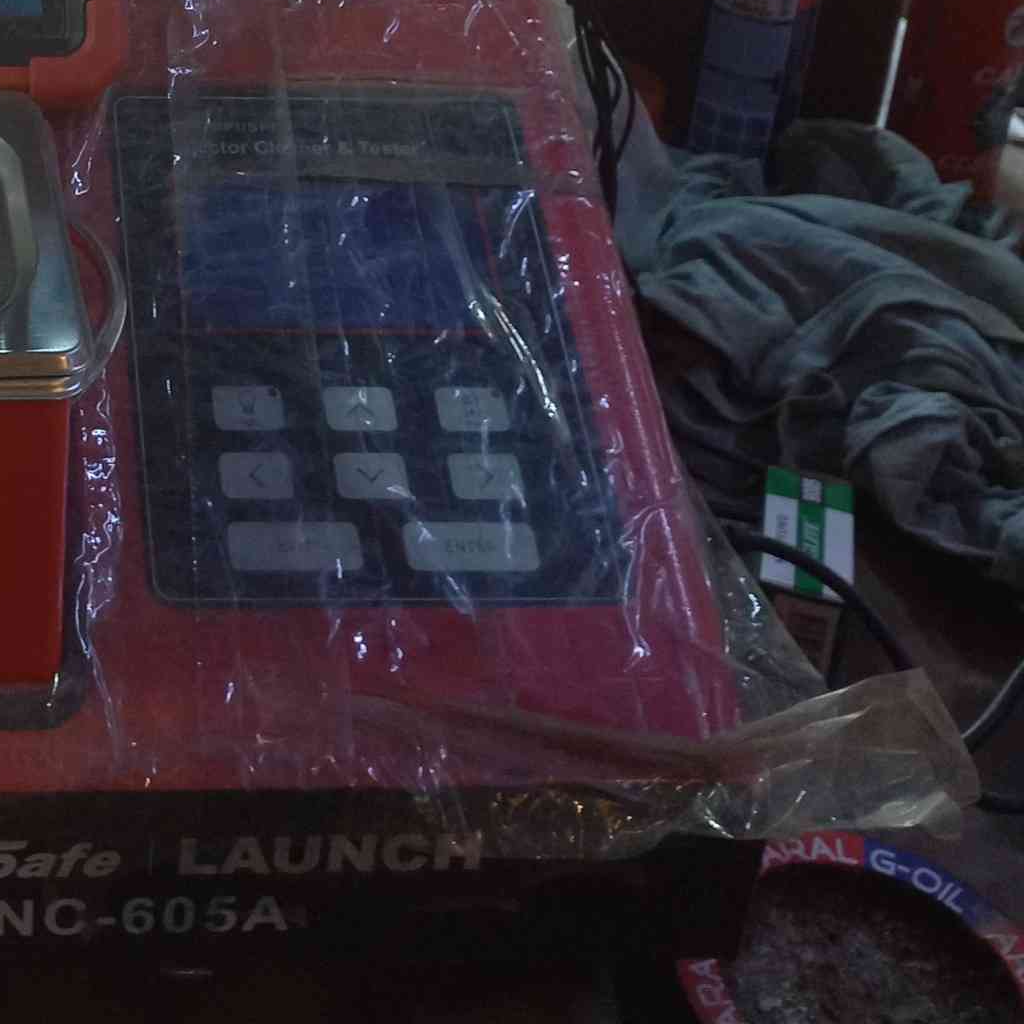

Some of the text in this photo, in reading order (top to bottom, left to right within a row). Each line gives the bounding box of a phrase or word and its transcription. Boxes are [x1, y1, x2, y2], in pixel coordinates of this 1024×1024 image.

[179, 833, 482, 875] LAUNCH
[761, 837, 964, 914] ARAL G-OIL
[690, 958, 743, 1024] ARA
